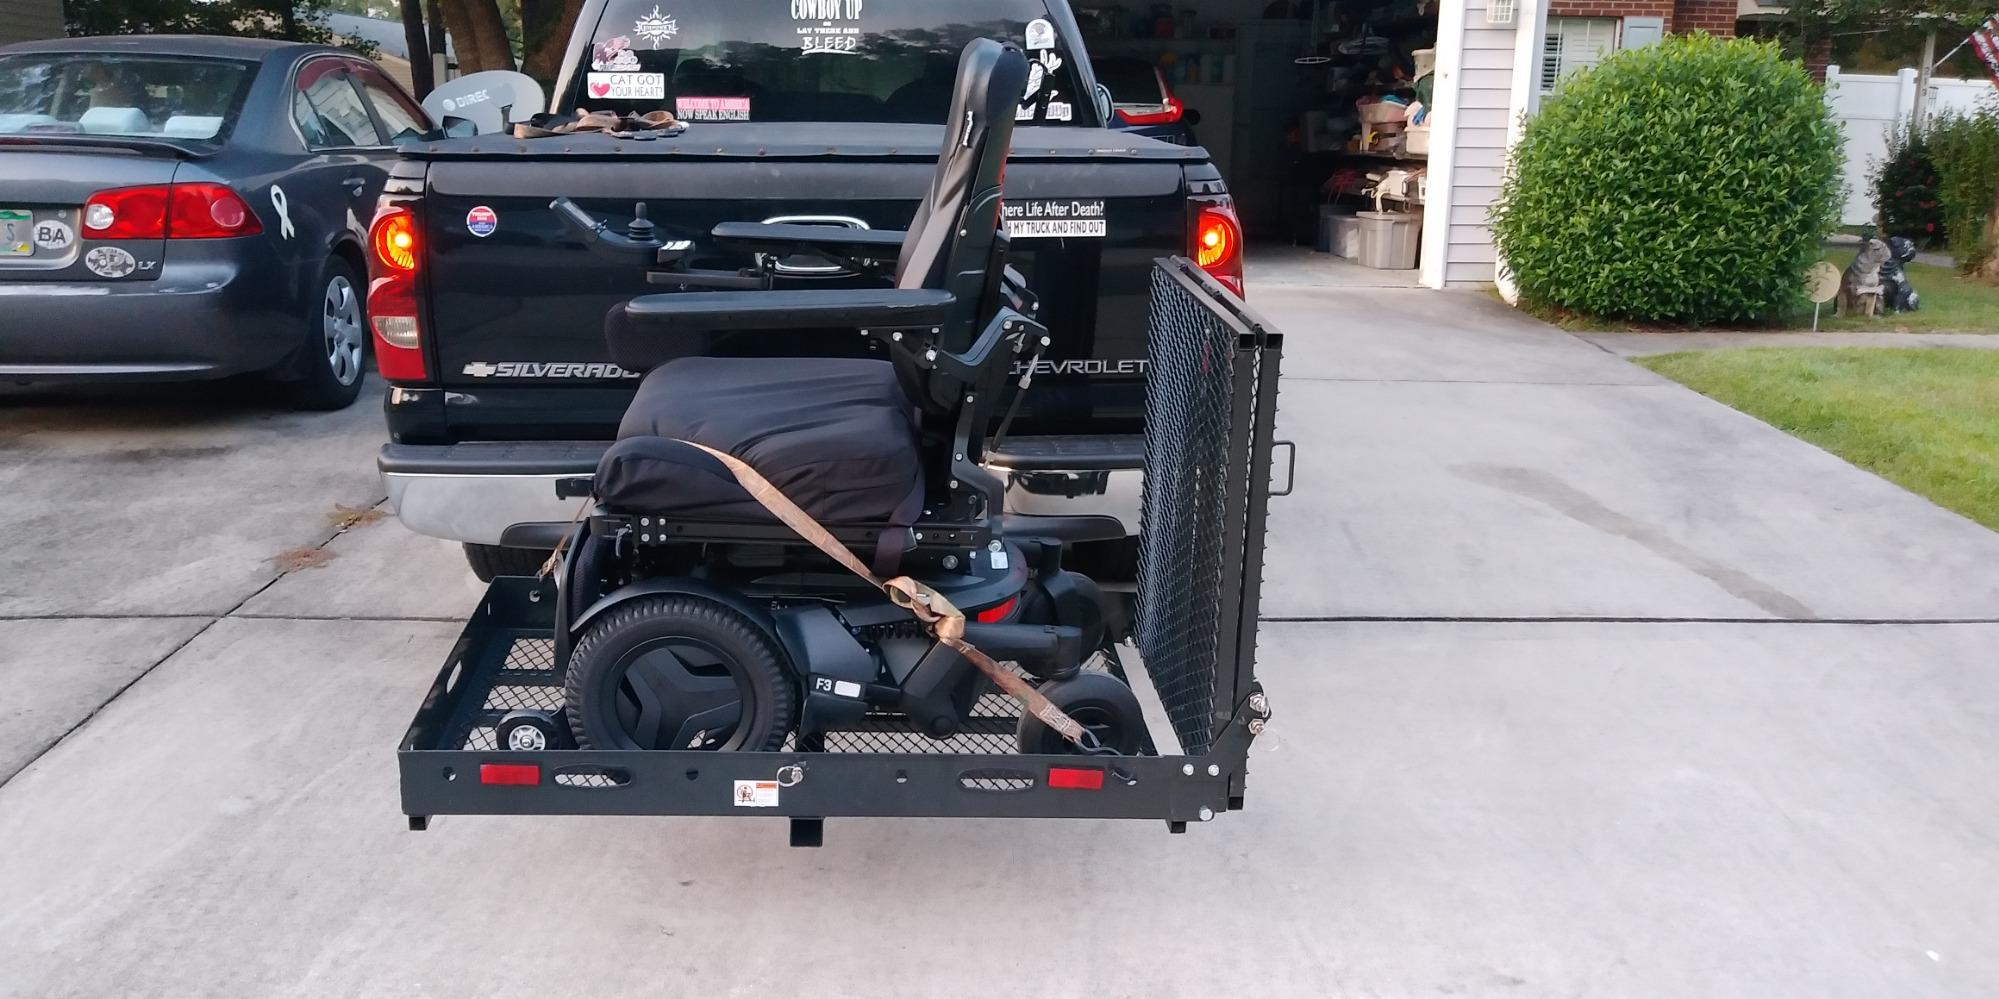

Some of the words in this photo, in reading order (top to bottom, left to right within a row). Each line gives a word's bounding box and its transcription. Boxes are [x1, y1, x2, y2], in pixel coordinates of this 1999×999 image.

[791, 0, 841, 20] COWBOY
[845, 0, 862, 20] UP
[801, 36, 856, 50] BLEED
[610, 75, 633, 85] CAT
[637, 75, 662, 85] GOT
[611, 87, 632, 97] YOUR
[634, 87, 663, 97] HEART?
[677, 110, 694, 120] NOW
[695, 110, 718, 120] SPEAK
[719, 110, 749, 120] ENGLISH
[1001, 201, 1024, 217] here
[1026, 201, 1043, 217] Life
[1044, 201, 1070, 217] After
[1072, 201, 1104, 217] Death?
[1014, 222, 1025, 234] MY
[1026, 222, 1051, 234] TRUCK
[1052, 222, 1068, 234] AND
[1070, 222, 1087, 233] FIND
[1088, 221, 1104, 233] OUT
[38, 226, 67, 244] BA
[816, 677, 832, 692] F3
